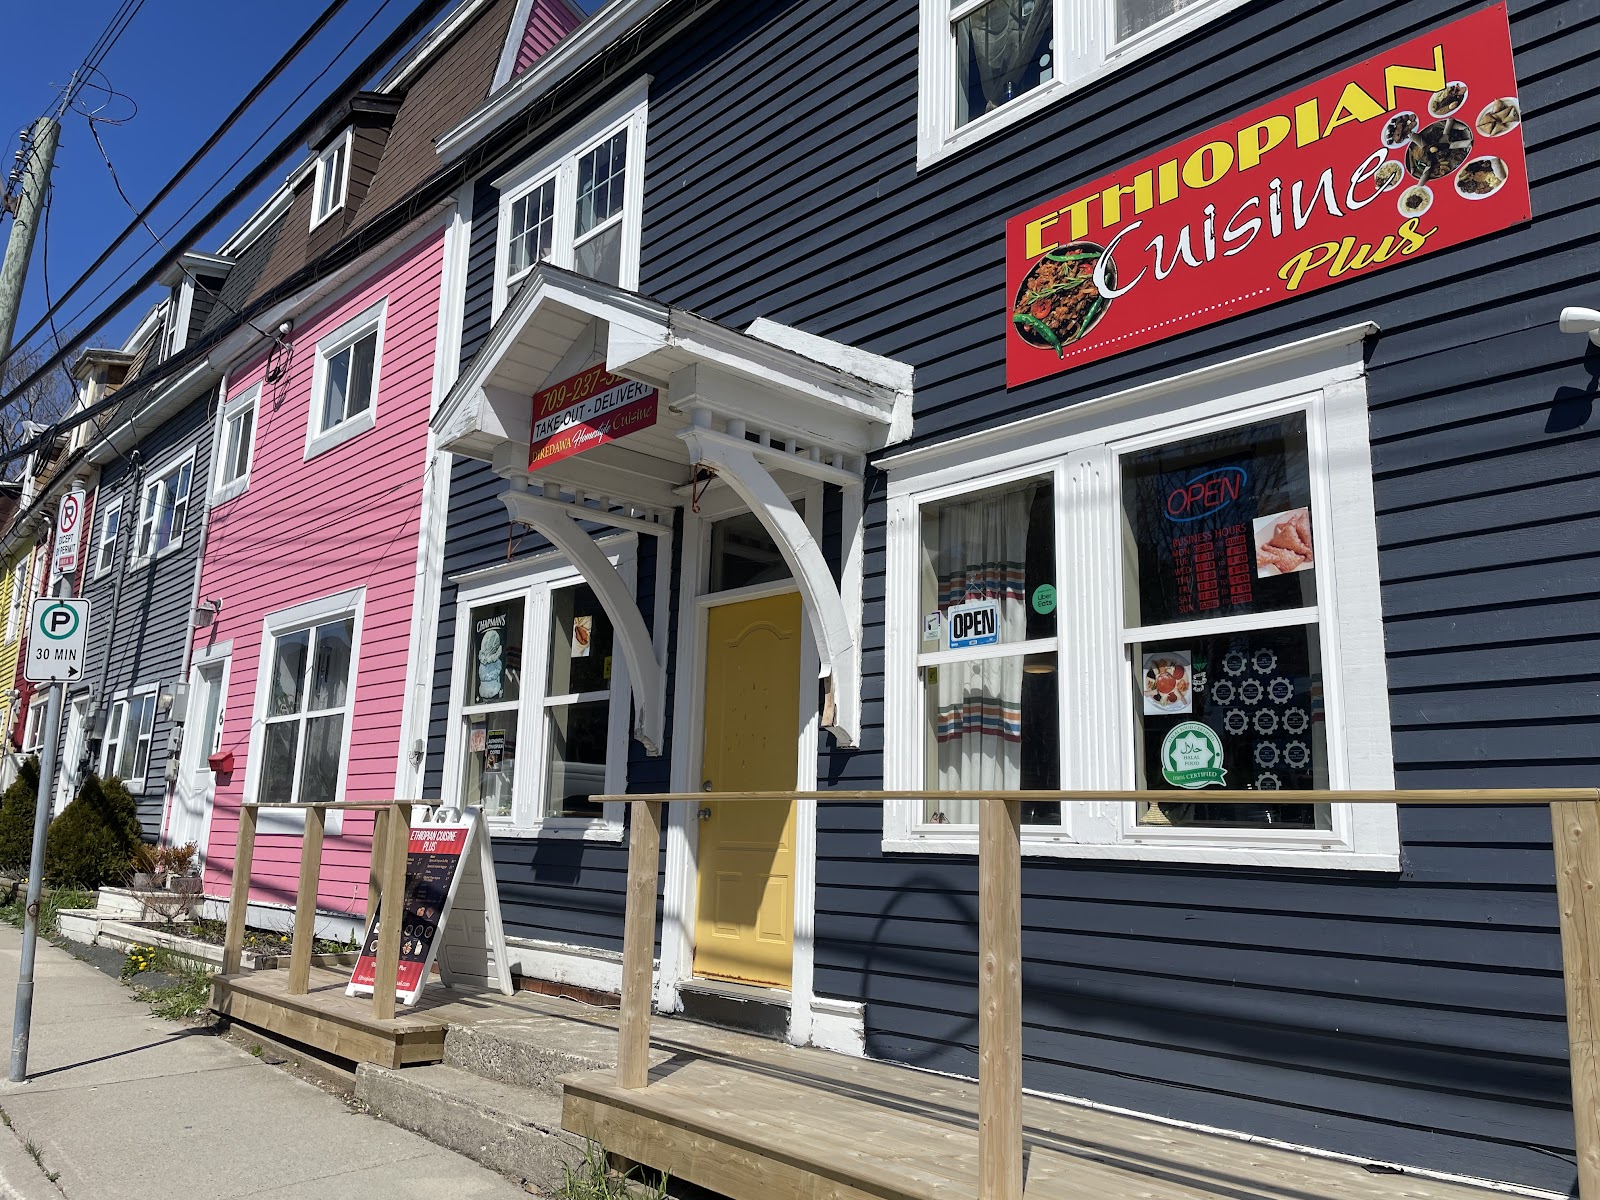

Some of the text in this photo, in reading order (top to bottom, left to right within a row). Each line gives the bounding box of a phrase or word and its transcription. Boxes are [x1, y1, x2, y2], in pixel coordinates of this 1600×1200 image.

[1025, 43, 1447, 261] ETHIOPIAN
[1092, 146, 1399, 300] Cuisine
[1278, 217, 1440, 292] Plus
[535, 403, 586, 438] TAKE-OUT
[612, 405, 653, 430] Cuisine
[1167, 473, 1241, 515] OPEN
[1172, 523, 1247, 547] BUSINESS HOURS
[1172, 547, 1190, 557] MON
[1226, 536, 1245, 546] CLOSED
[1174, 567, 1191, 576] WED
[1175, 558, 1189, 566] TUE
[1178, 586, 1191, 595] FRI
[1178, 595, 1192, 604] SAT
[476, 613, 507, 633] CHAPMAN'S
[953, 608, 995, 639] OPEN
[36, 648, 77, 660] 30 MIN
[1186, 771, 1218, 780] CERTIFIED
[410, 830, 458, 842] ETHIOPIAN CUISINE
[421, 841, 438, 852] PLUS
